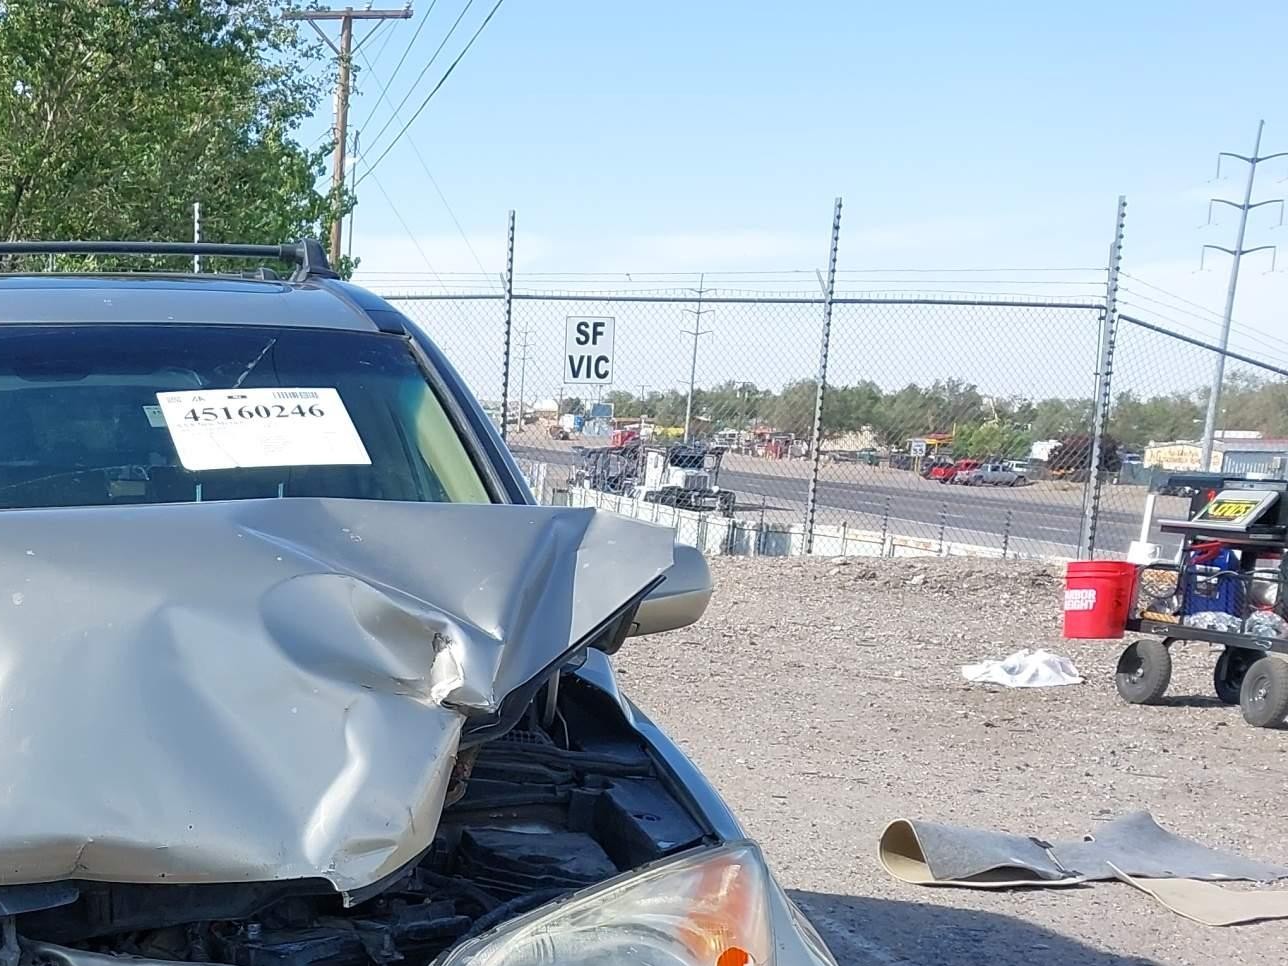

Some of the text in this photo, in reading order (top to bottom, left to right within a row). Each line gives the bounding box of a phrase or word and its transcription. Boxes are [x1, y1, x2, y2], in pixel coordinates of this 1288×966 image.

[575, 321, 605, 346] SF
[568, 354, 610, 380] VIC
[184, 403, 325, 422] 45160246
